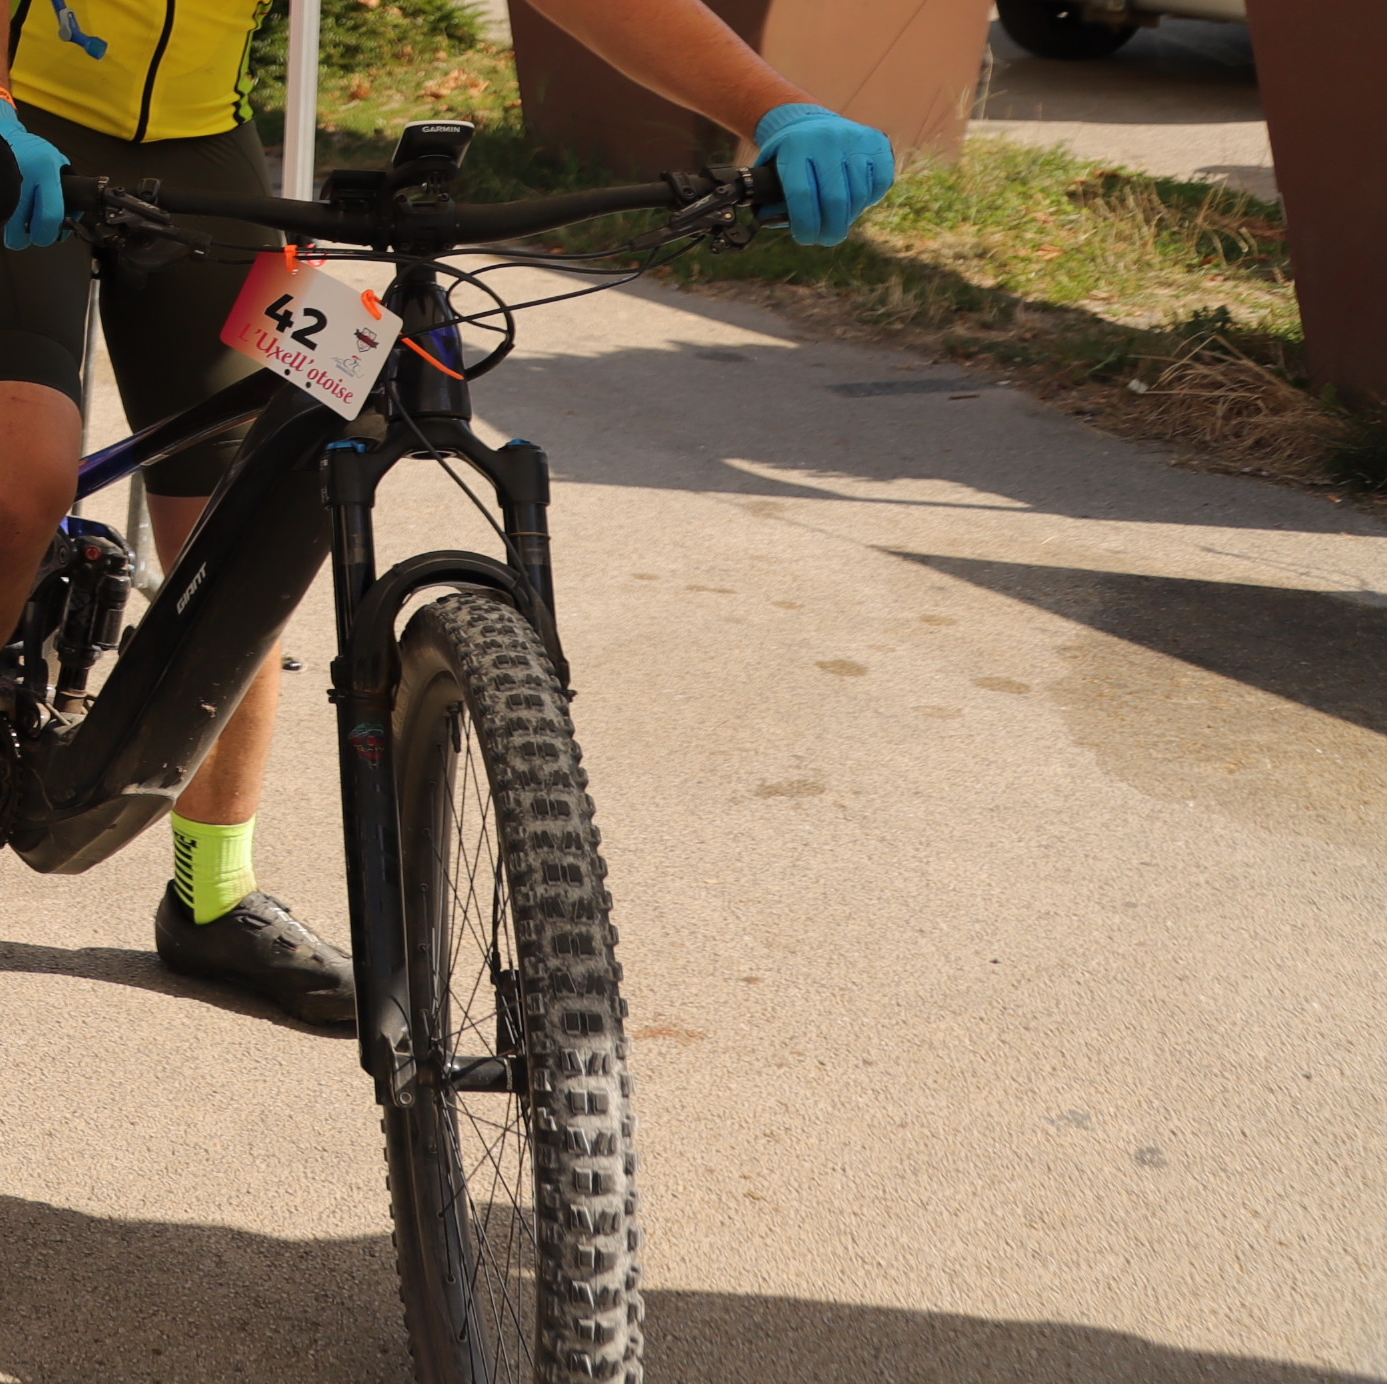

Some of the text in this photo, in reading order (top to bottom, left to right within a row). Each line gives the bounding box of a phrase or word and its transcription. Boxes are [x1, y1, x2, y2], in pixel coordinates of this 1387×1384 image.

[421, 126, 462, 134] GARMIN
[264, 293, 328, 352] 42
[237, 322, 355, 406] L'Uxell'otoise
[176, 560, 207, 615] GIANT
